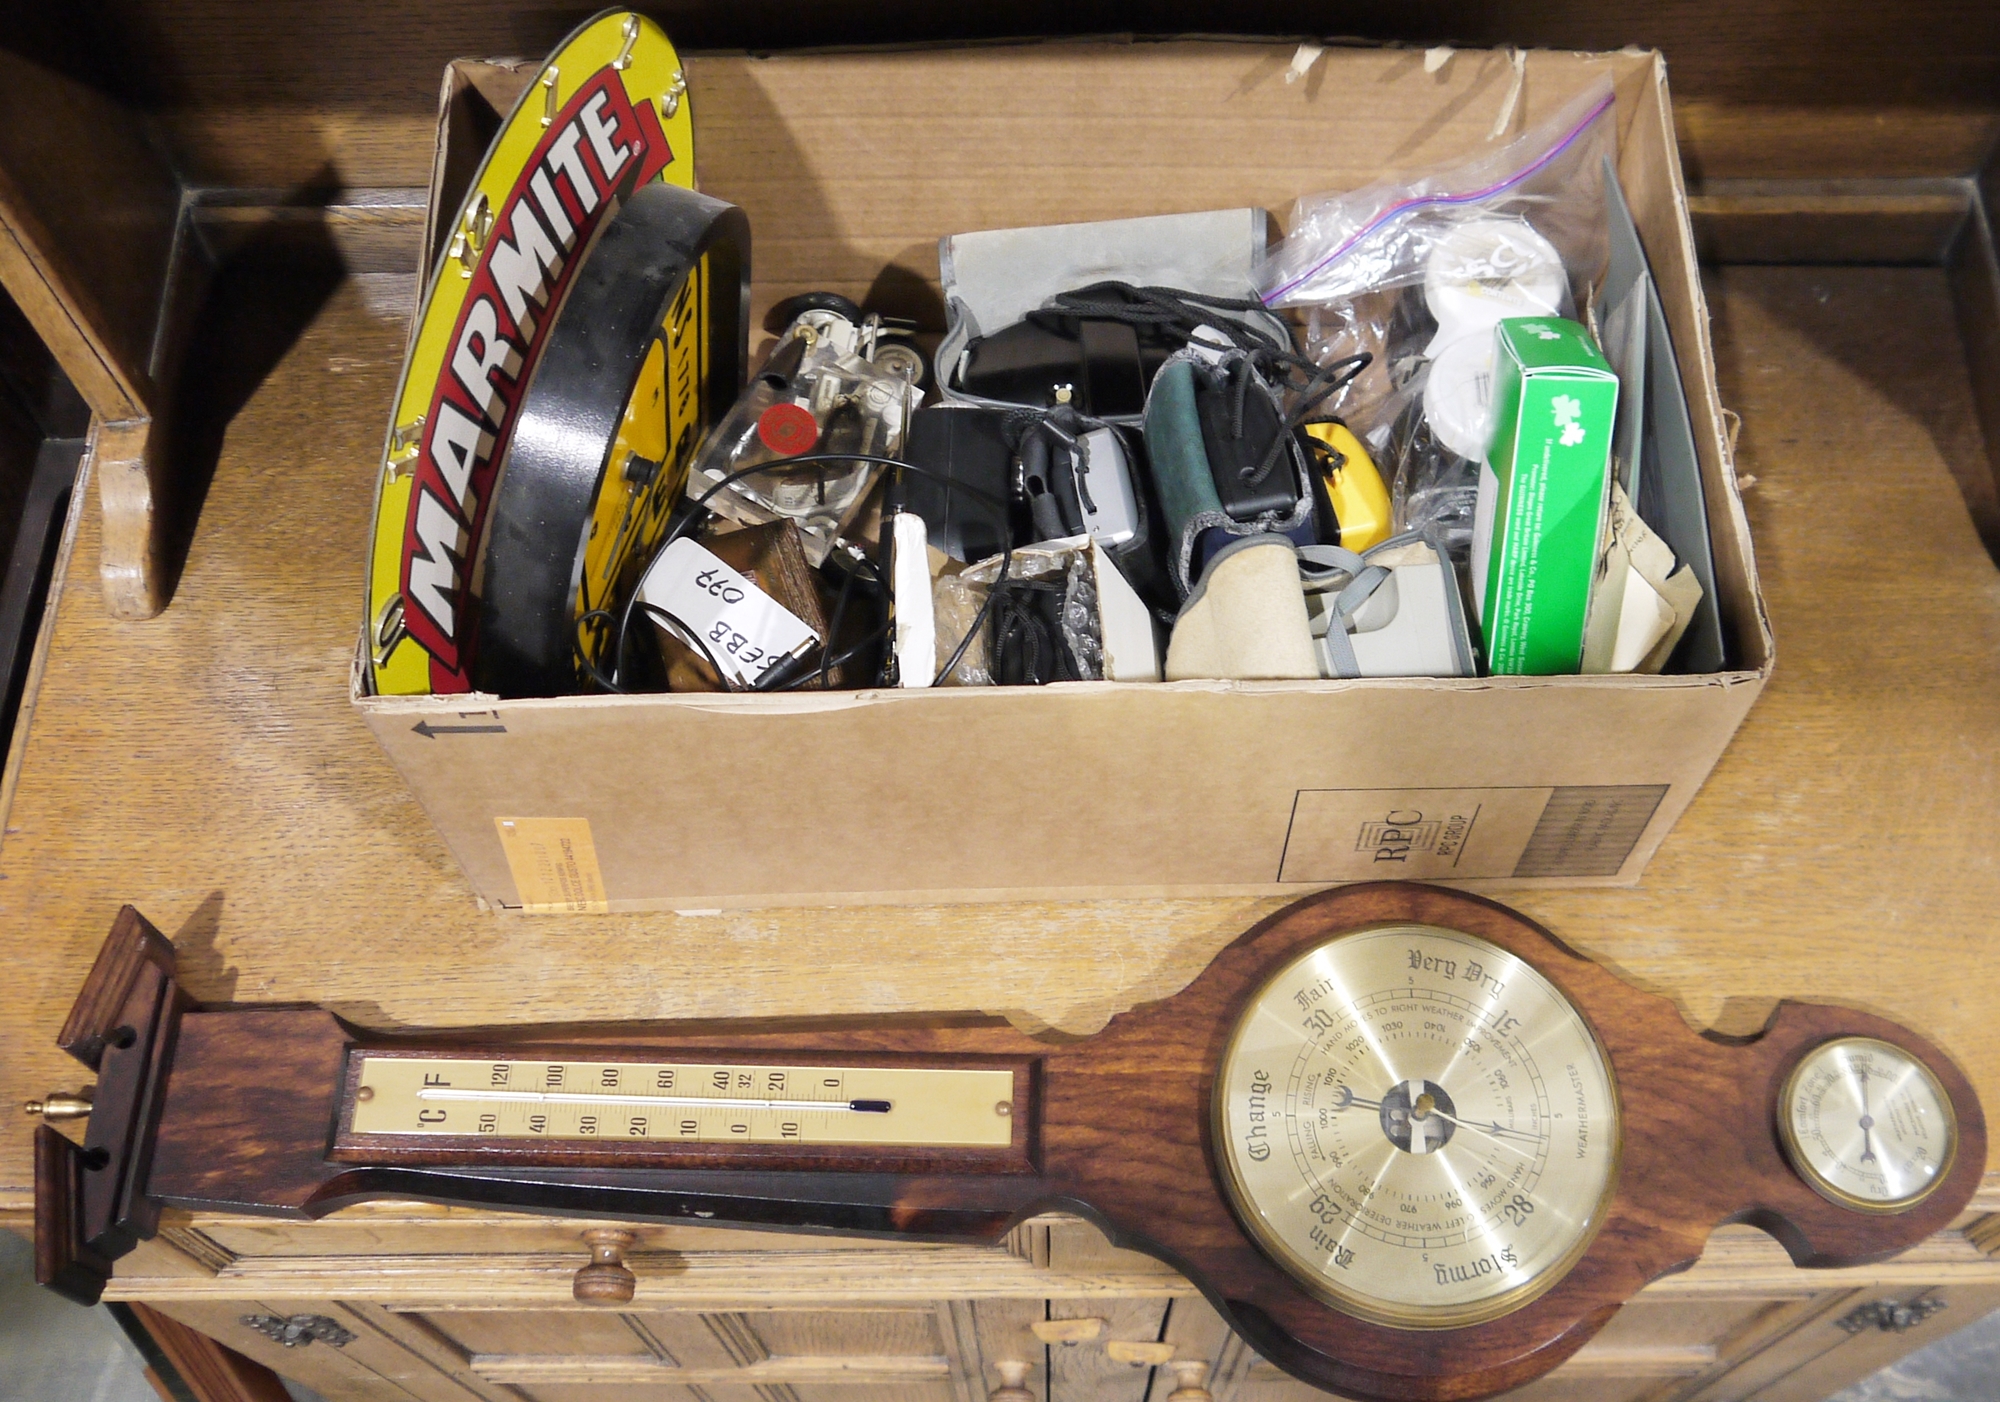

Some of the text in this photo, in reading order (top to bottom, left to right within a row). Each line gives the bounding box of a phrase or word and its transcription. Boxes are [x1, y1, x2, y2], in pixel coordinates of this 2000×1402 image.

[408, 88, 630, 640] MARMITE
[1516, 485, 1526, 515] GUINNESS
[1538, 483, 1546, 501] please
[1535, 503, 1543, 521] return
[1373, 810, 1422, 863] RPC
[1407, 949, 1506, 1000] Very Dry
[1408, 977, 1414, 985] 5
[1302, 1009, 1334, 1039] 30
[1320, 1004, 1518, 1068] HAND MOES TO RIGHT WEATHER IMPROVEMENT
[1381, 1022, 1403, 1032] 1030
[1424, 1021, 1446, 1032] 1040
[1345, 1035, 1365, 1052] 1020
[490, 1064, 840, 1092] 120 100 80 60 40 32 20 0
[1302, 1073, 1316, 1106] RISING
[1323, 1067, 1337, 1086] 1010
[1245, 1069, 1272, 1163] Change
[1319, 1108, 1328, 1130] 1000
[1530, 1103, 1538, 1130] INCHES
[1566, 1062, 1588, 1159] WEATHERMASTER
[1797, 1097, 1808, 1135] Comfort
[478, 1113, 799, 1139] 50 40 30 20 10 0 10
[1303, 1121, 1320, 1160] FALLING
[1329, 1150, 1343, 1169] 990
[1506, 1162, 1525, 1189] HAND
[1327, 1177, 1392, 1227] DETERIORATION
[1357, 1184, 1375, 1200] 980
[1480, 1188, 1507, 1214] MOVES
[1309, 1193, 1343, 1225] 29
[1400, 1203, 1417, 1214] 970
[1504, 1194, 1534, 1228] 28
[1396, 1220, 1442, 1231] WEATHER
[1446, 1216, 1465, 1229] LEFT
[1309, 1225, 1356, 1270] Rain
[1422, 1253, 1428, 1262] 5
[1433, 1244, 1518, 1285] Stormy
